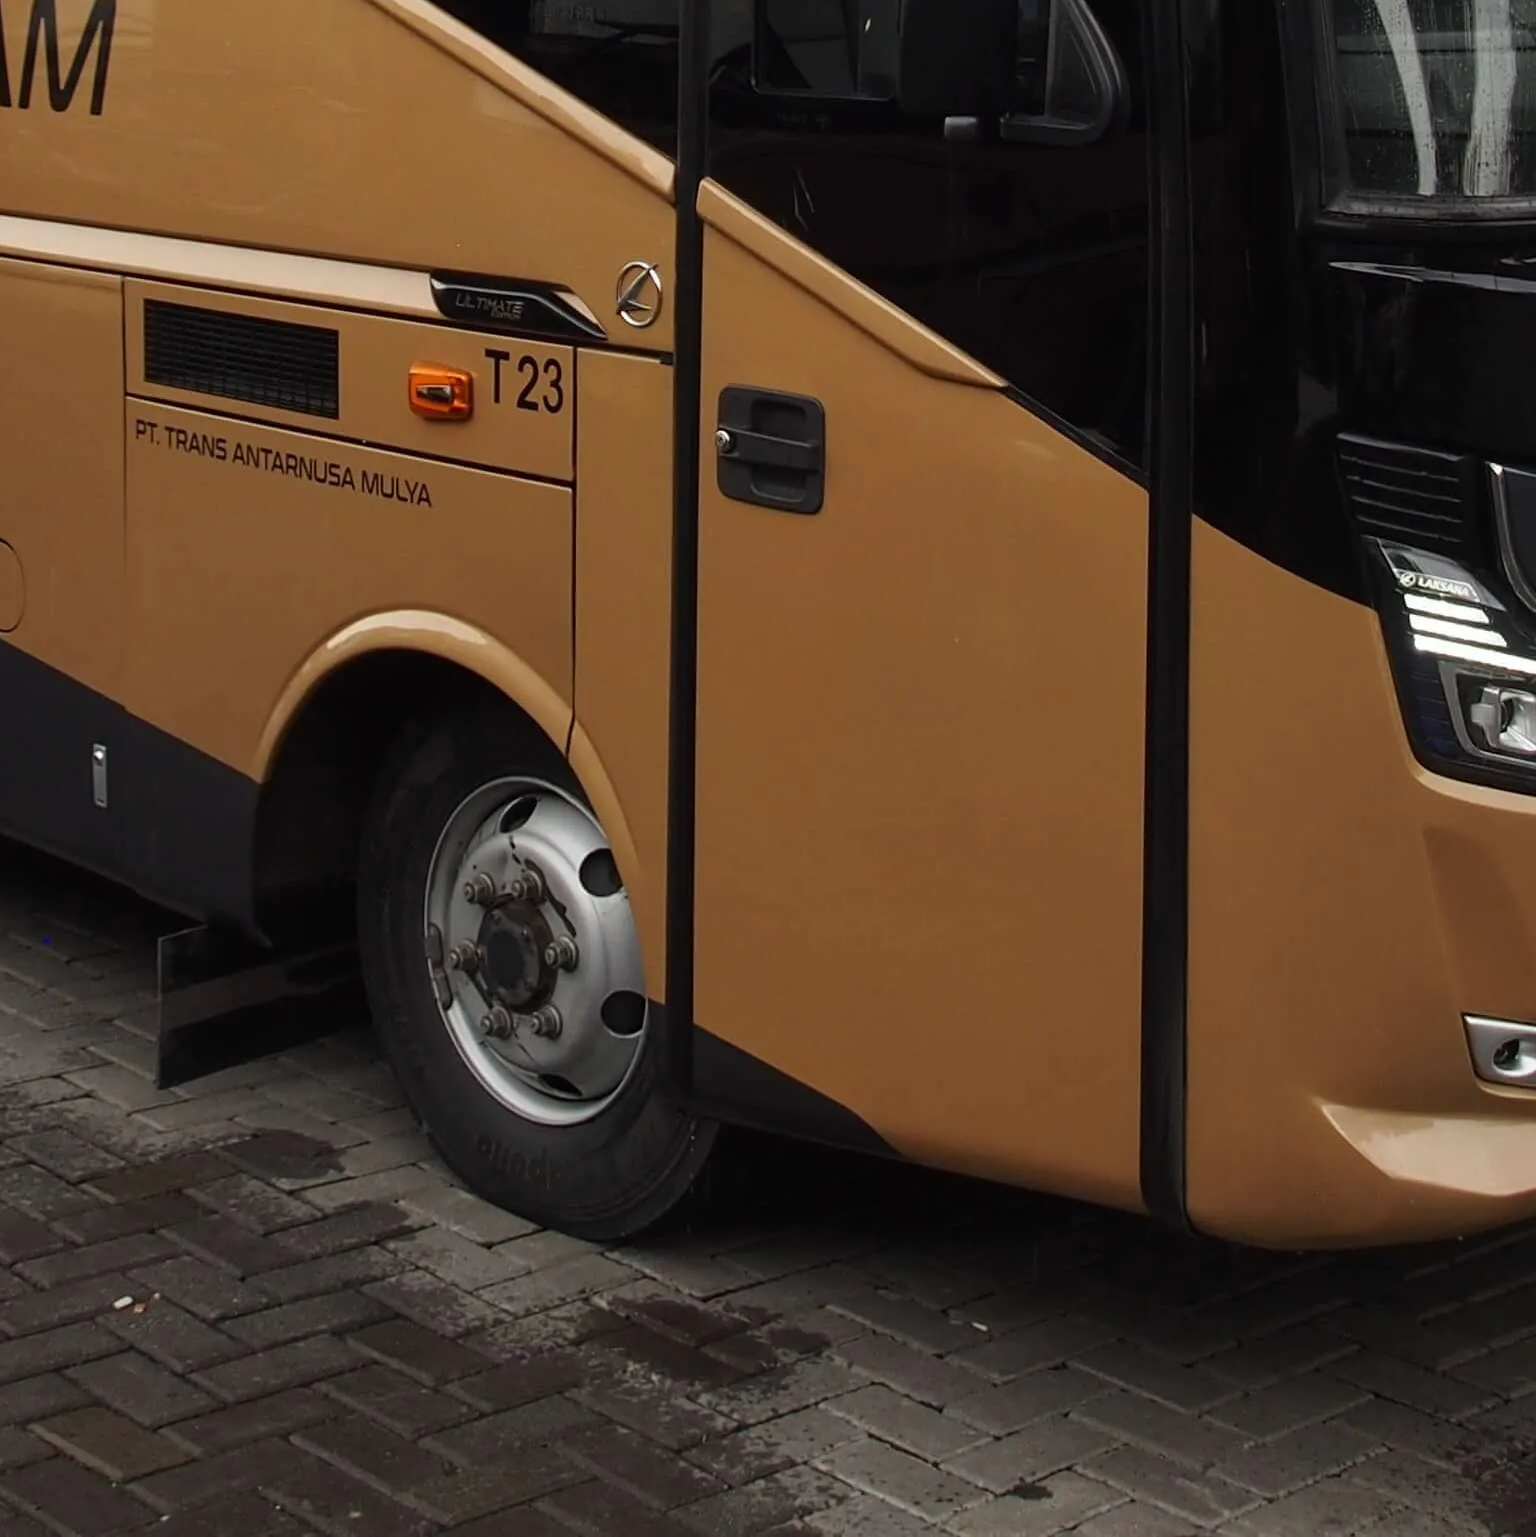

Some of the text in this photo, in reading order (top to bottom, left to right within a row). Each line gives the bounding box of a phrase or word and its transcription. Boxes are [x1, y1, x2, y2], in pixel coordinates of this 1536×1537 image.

[456, 292, 525, 315] ULTIMATE
[135, 417, 432, 508] PT. TRANS ANTARNUSA MULYA
[1417, 577, 1470, 596] LAKSANA
